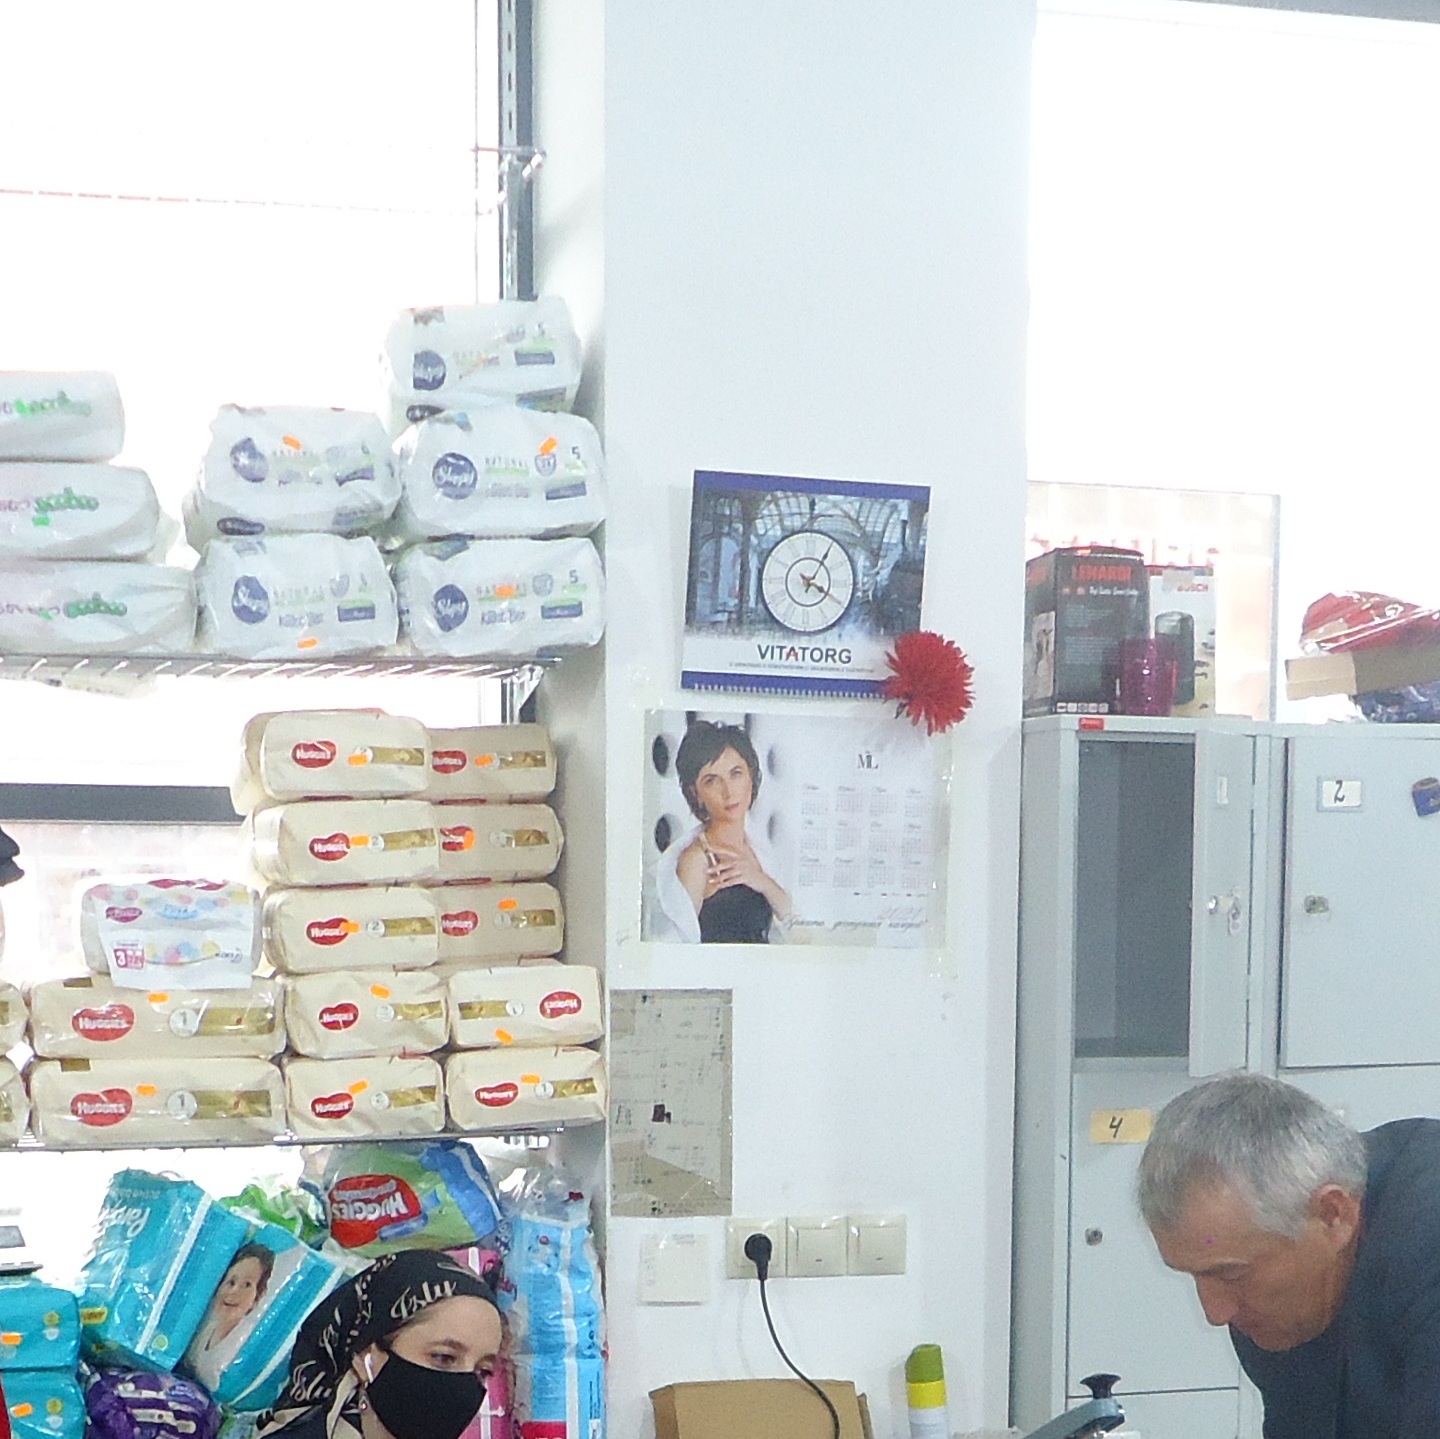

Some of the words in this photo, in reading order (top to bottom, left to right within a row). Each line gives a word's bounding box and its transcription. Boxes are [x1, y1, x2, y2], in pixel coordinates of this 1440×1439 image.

[571, 446, 581, 460] 5
[569, 570, 579, 583] 5
[757, 644, 852, 664] VITATORG
[1334, 780, 1345, 803] 2
[117, 950, 128, 967] 3
[180, 1011, 188, 1026] 1
[178, 1096, 186, 1109] 1
[1109, 1116, 1123, 1138] 4
[332, 1192, 408, 1221] HUGGIES
